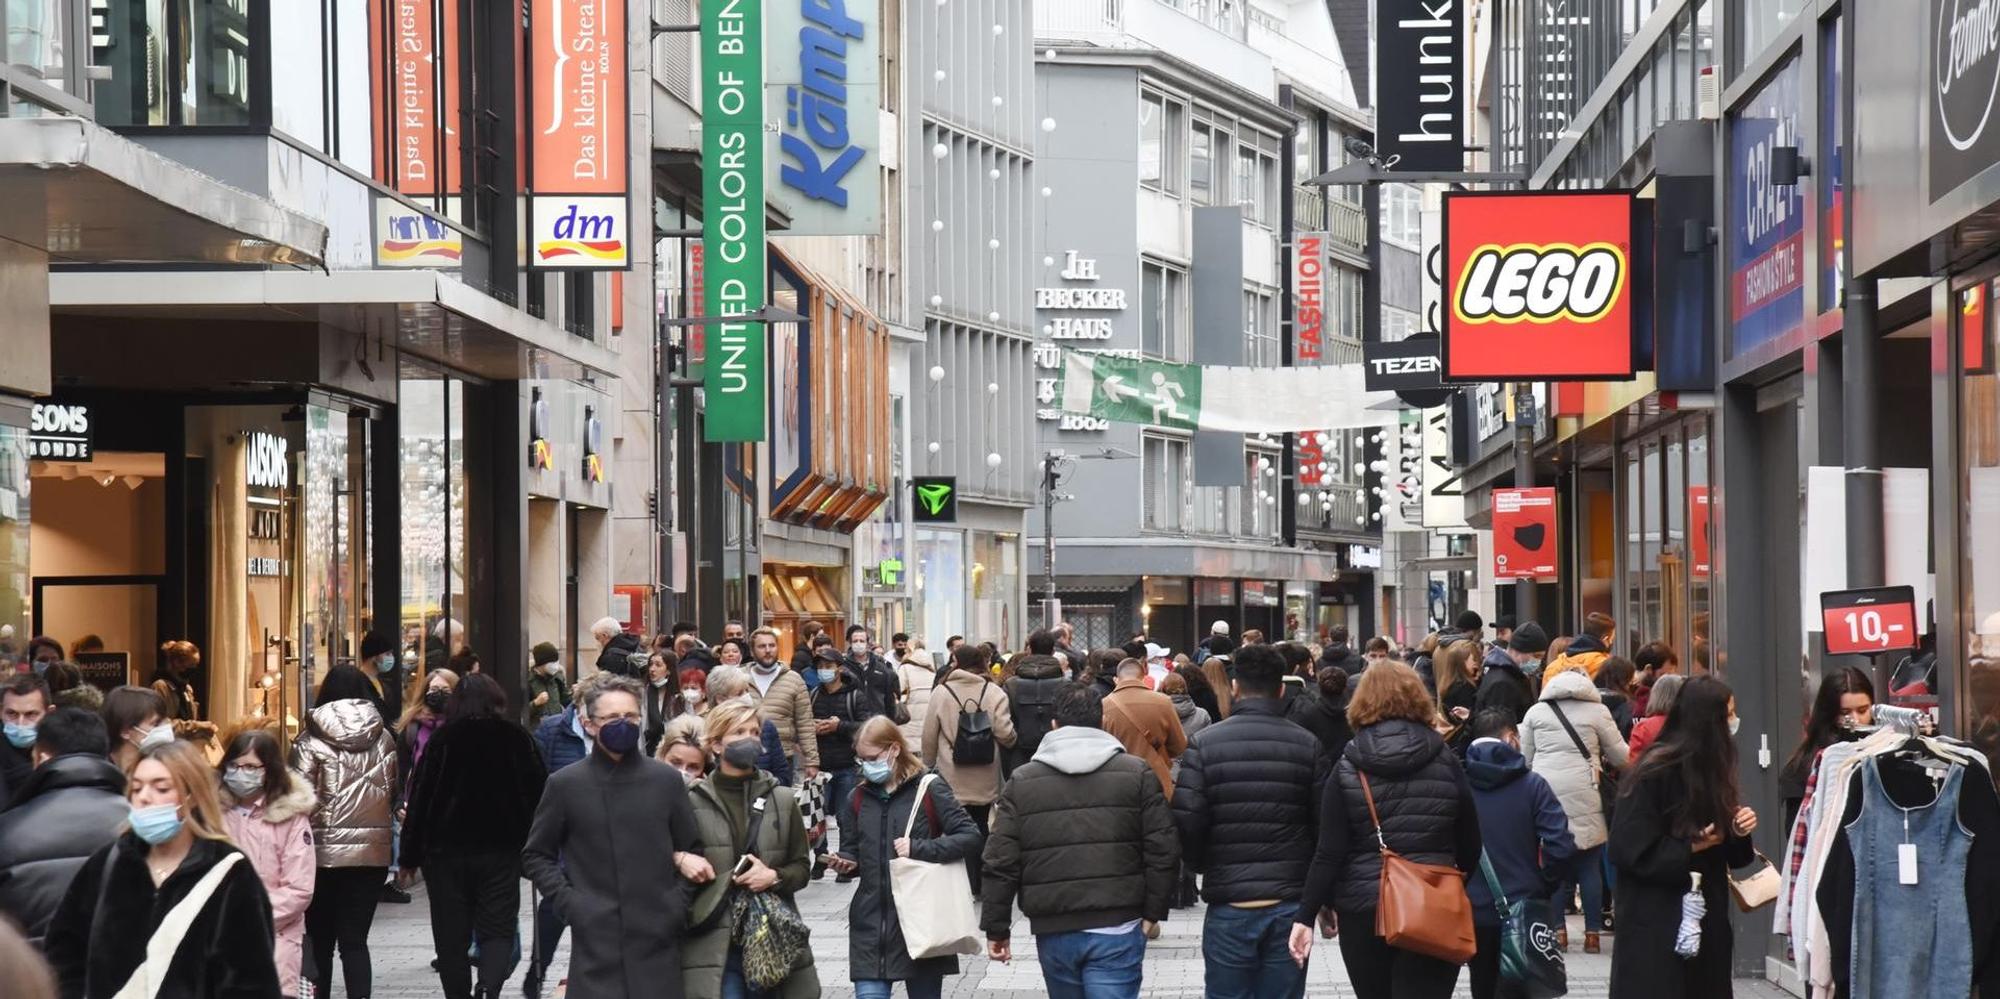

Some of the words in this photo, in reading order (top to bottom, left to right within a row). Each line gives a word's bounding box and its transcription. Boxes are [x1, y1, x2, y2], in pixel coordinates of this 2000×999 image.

[573, 0, 595, 52] Stea
[718, 0, 744, 55] BEN
[600, 40, 610, 74] KÖLN
[1398, 0, 1452, 142] hunk
[573, 60, 596, 128] kleine
[718, 70, 745, 115] OF
[781, 0, 867, 209] Kämp
[573, 135, 597, 179] Das
[1746, 112, 1798, 246] CRAZY
[553, 204, 614, 240] dm
[718, 131, 746, 263] COLORS
[1036, 287, 1128, 310] BECKER
[1299, 237, 1322, 360] FASHION
[1459, 247, 1620, 319] LEGO
[720, 279, 747, 393] UNITED
[1052, 317, 1113, 340] HAUS
[31, 404, 88, 434] SONS
[1844, 610, 1905, 648] 10,-
